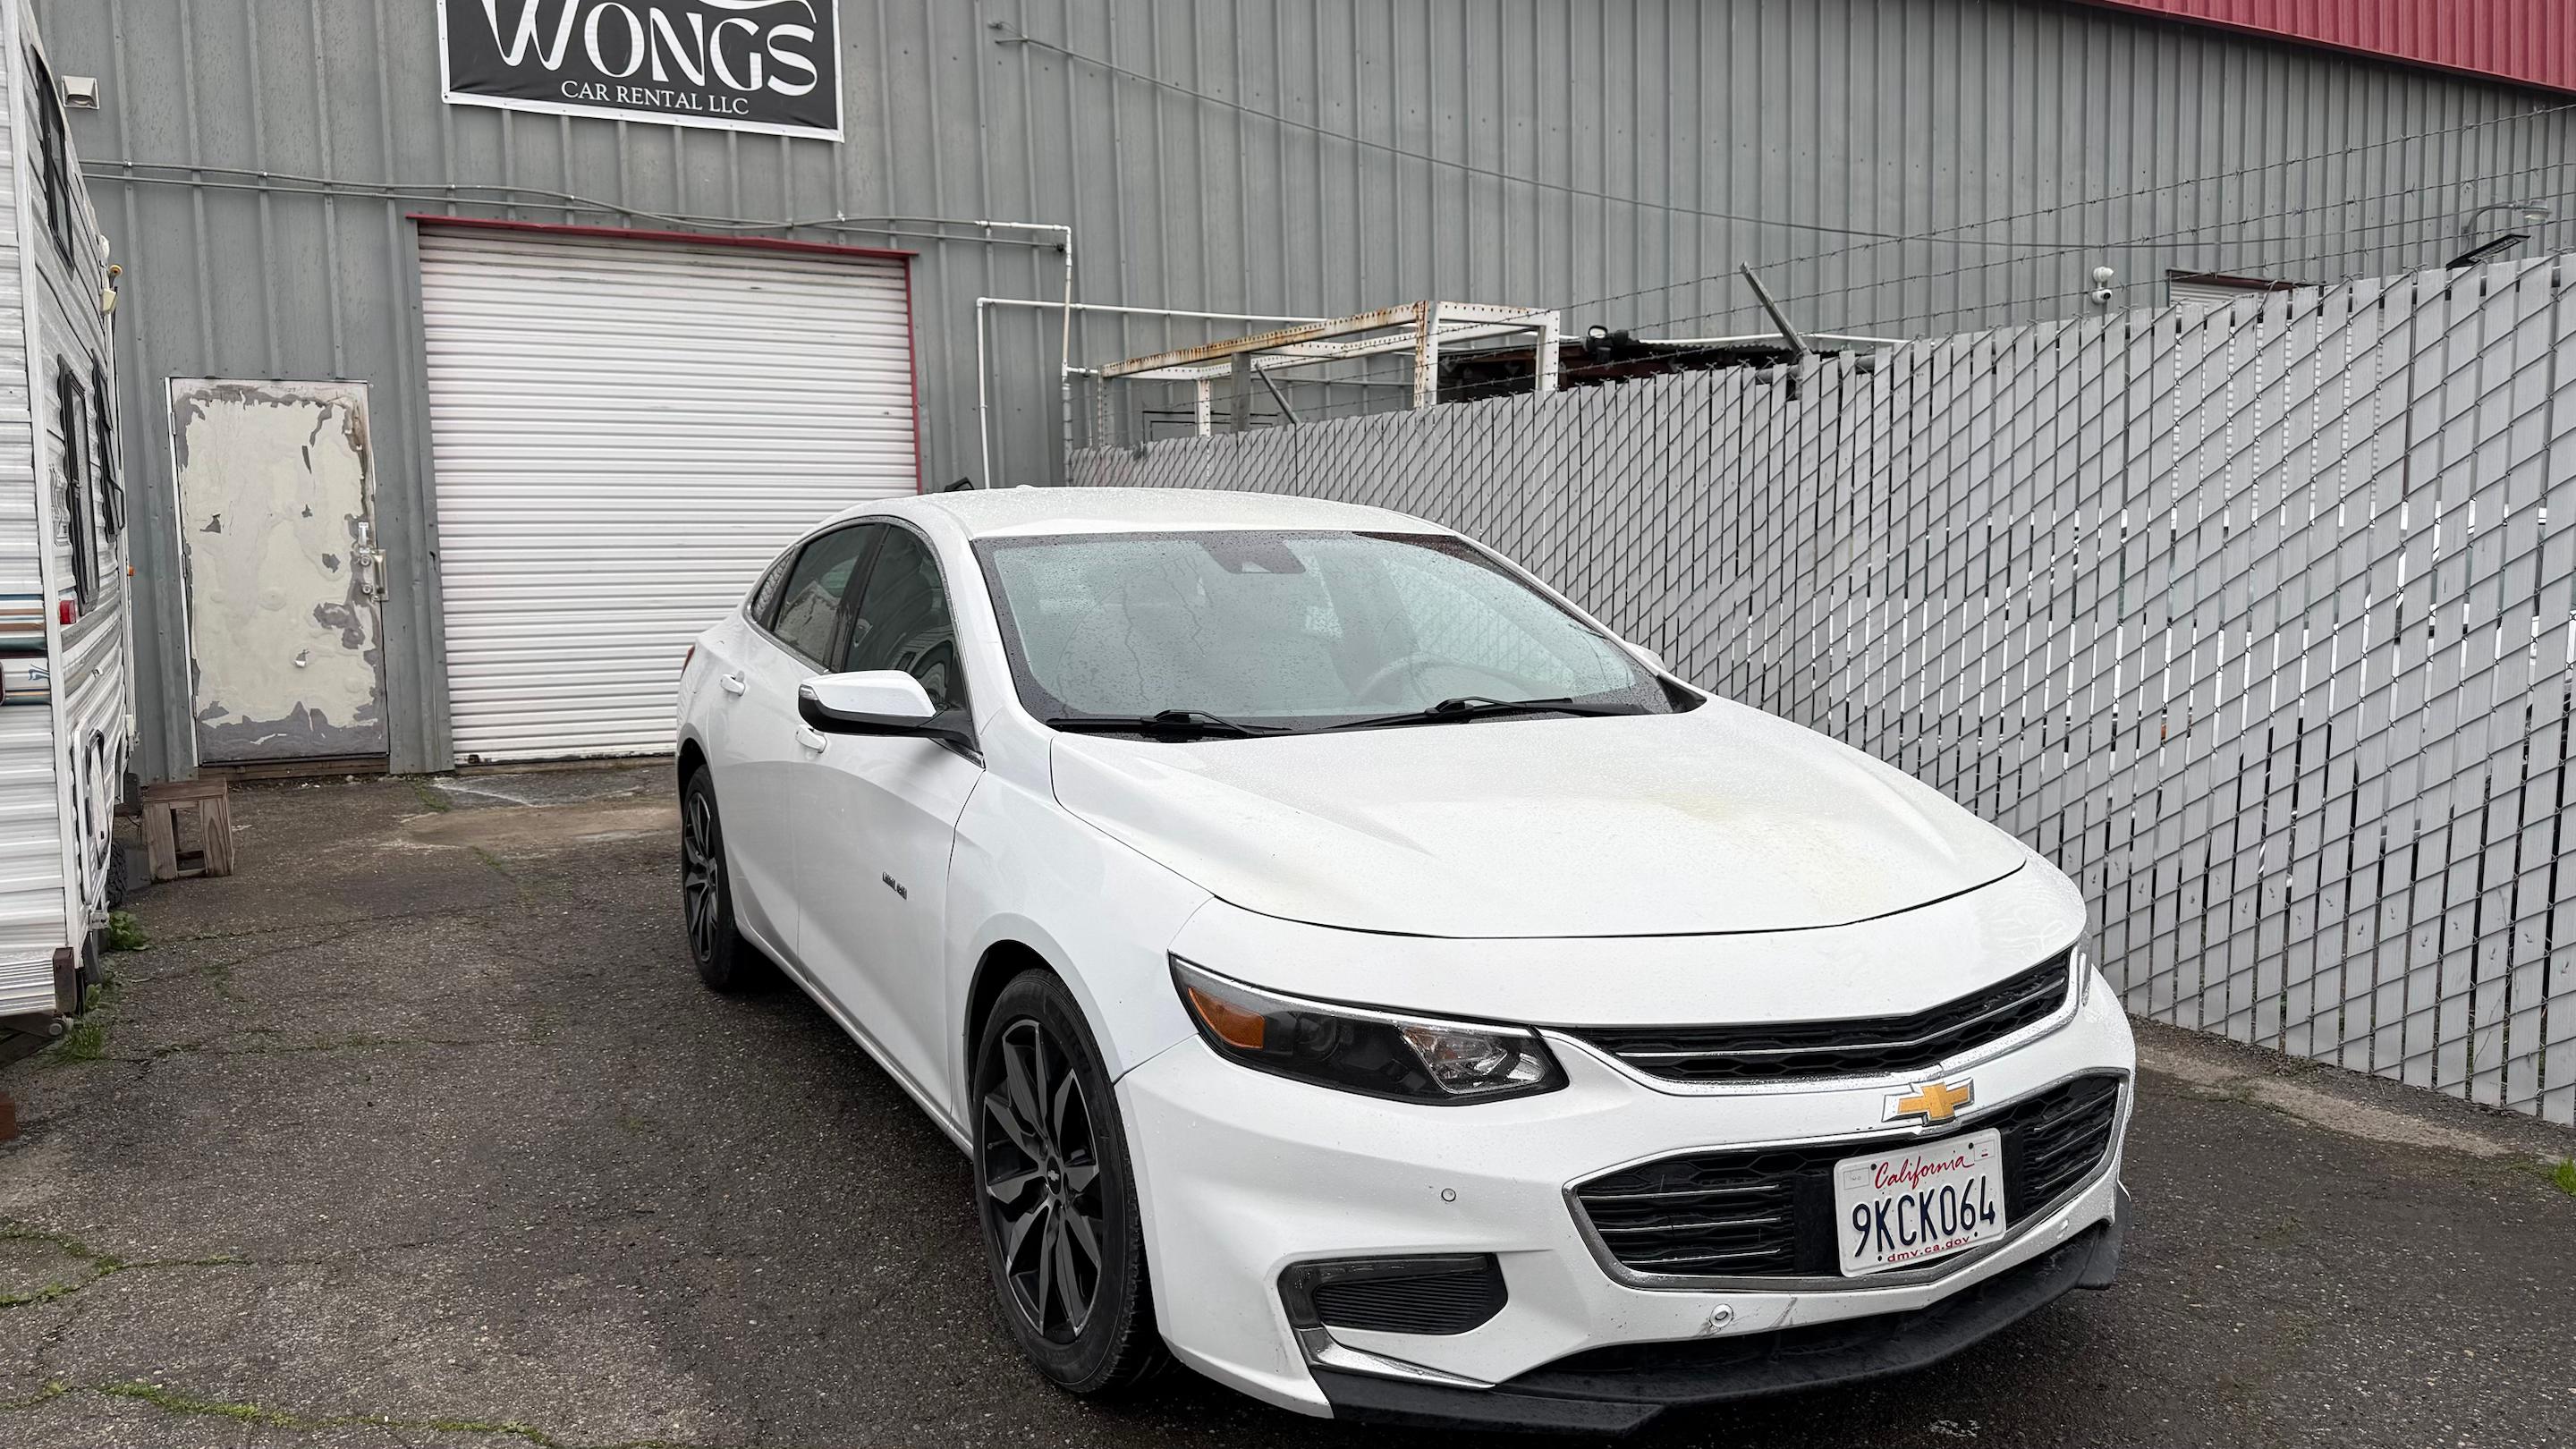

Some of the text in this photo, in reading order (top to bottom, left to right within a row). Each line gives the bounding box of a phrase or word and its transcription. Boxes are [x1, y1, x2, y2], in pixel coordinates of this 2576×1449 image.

[481, 0, 818, 97] WONGS
[561, 80, 750, 115] CAR RENTAL LLC
[1875, 1156, 1975, 1190] California
[1852, 1174, 1996, 1258] 9KCK064
[1886, 1235, 1970, 1263] dmv.ca.gov
